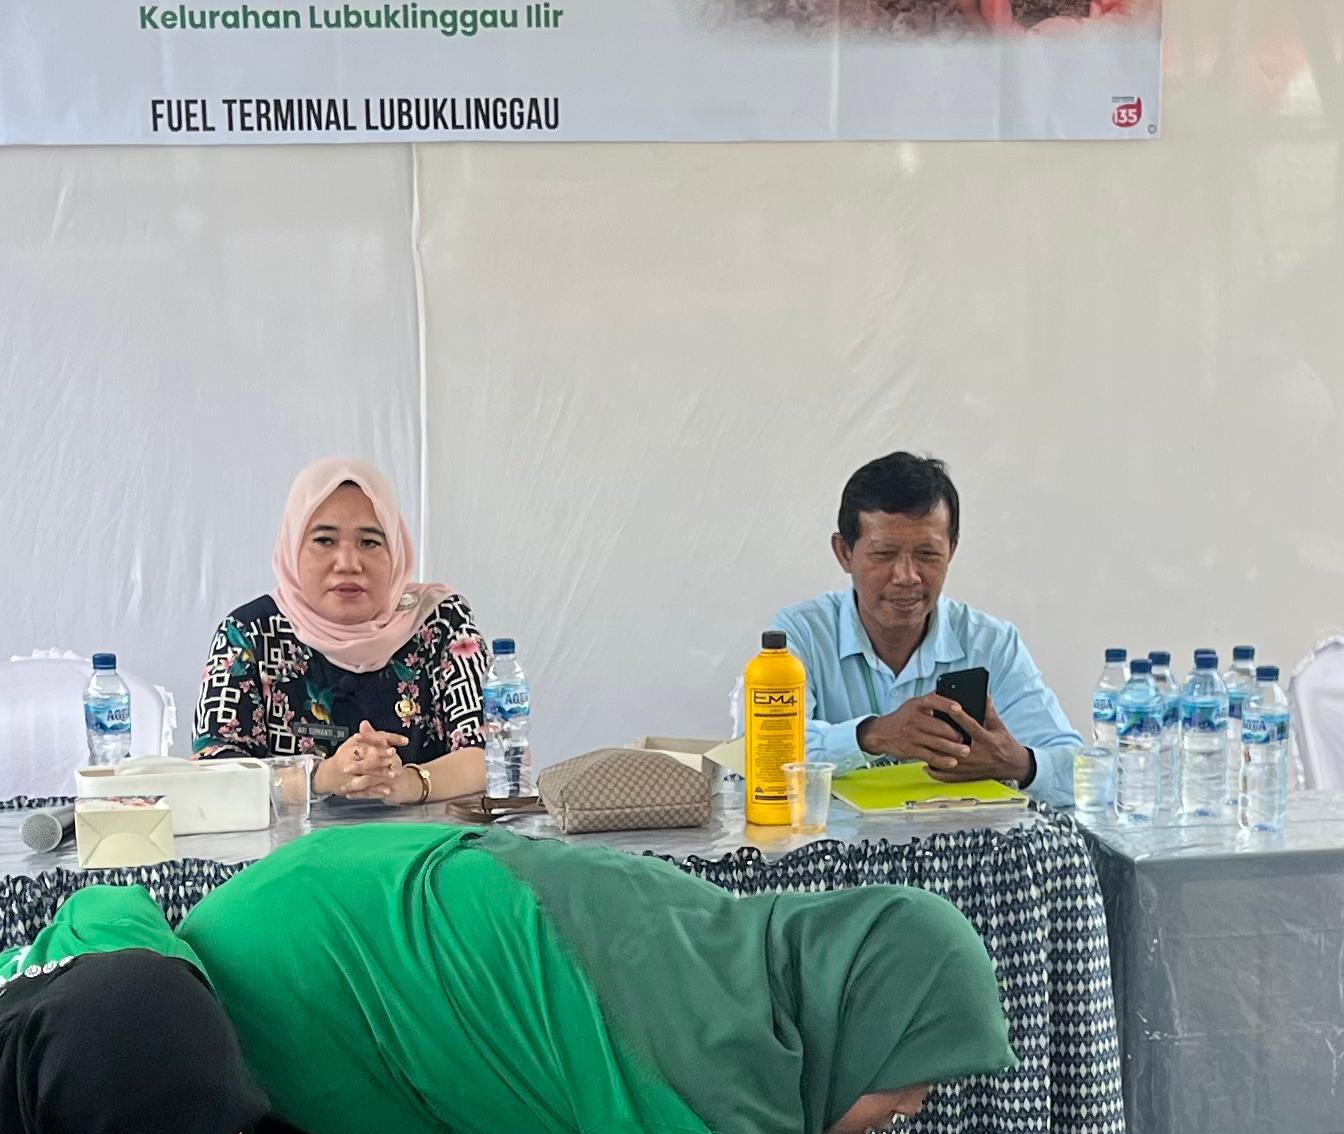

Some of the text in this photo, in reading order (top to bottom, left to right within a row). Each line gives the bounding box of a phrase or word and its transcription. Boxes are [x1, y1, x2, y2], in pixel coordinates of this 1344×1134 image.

[139, 2, 564, 37] Kelurahan Lubuklinggau Ilir
[151, 97, 560, 132] FUEL TERMINAL LUBUKLINGGAU
[753, 689, 798, 706] EM4
